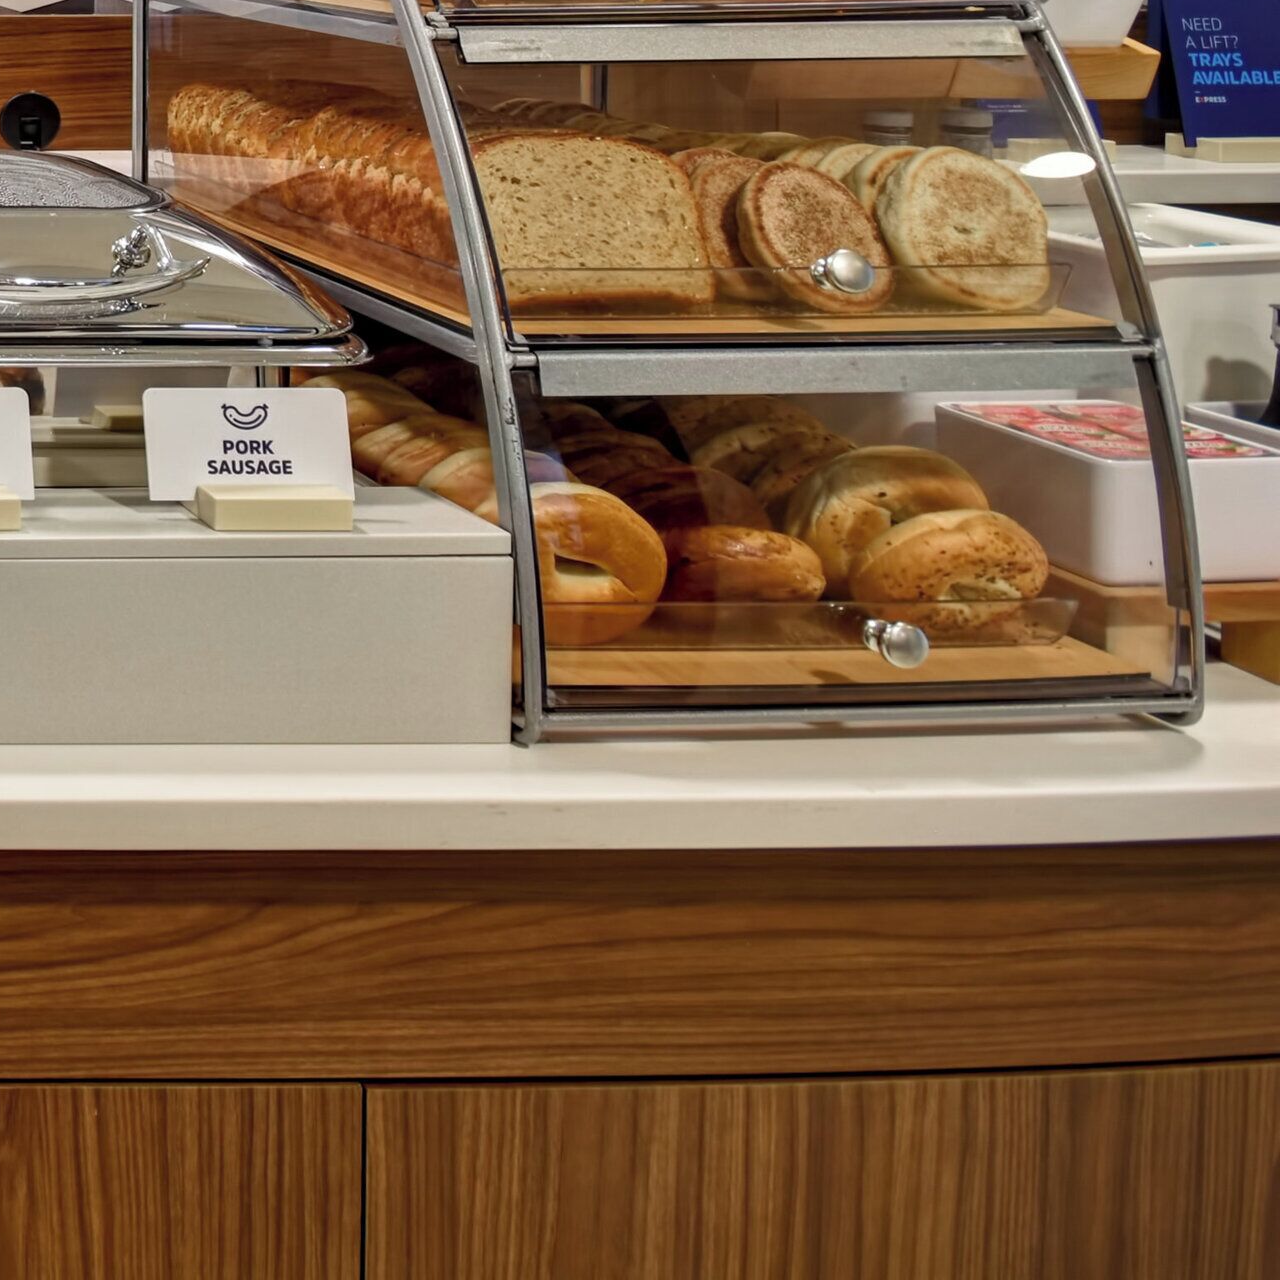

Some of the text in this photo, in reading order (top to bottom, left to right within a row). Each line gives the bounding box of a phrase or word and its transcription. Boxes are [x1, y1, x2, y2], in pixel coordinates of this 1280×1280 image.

[1182, 17, 1222, 31] NEED
[1185, 35, 1239, 49] A LIFT?
[1188, 53, 1243, 67] TRAYS
[222, 440, 274, 455] PORK
[208, 459, 293, 475] SAUSAGE
